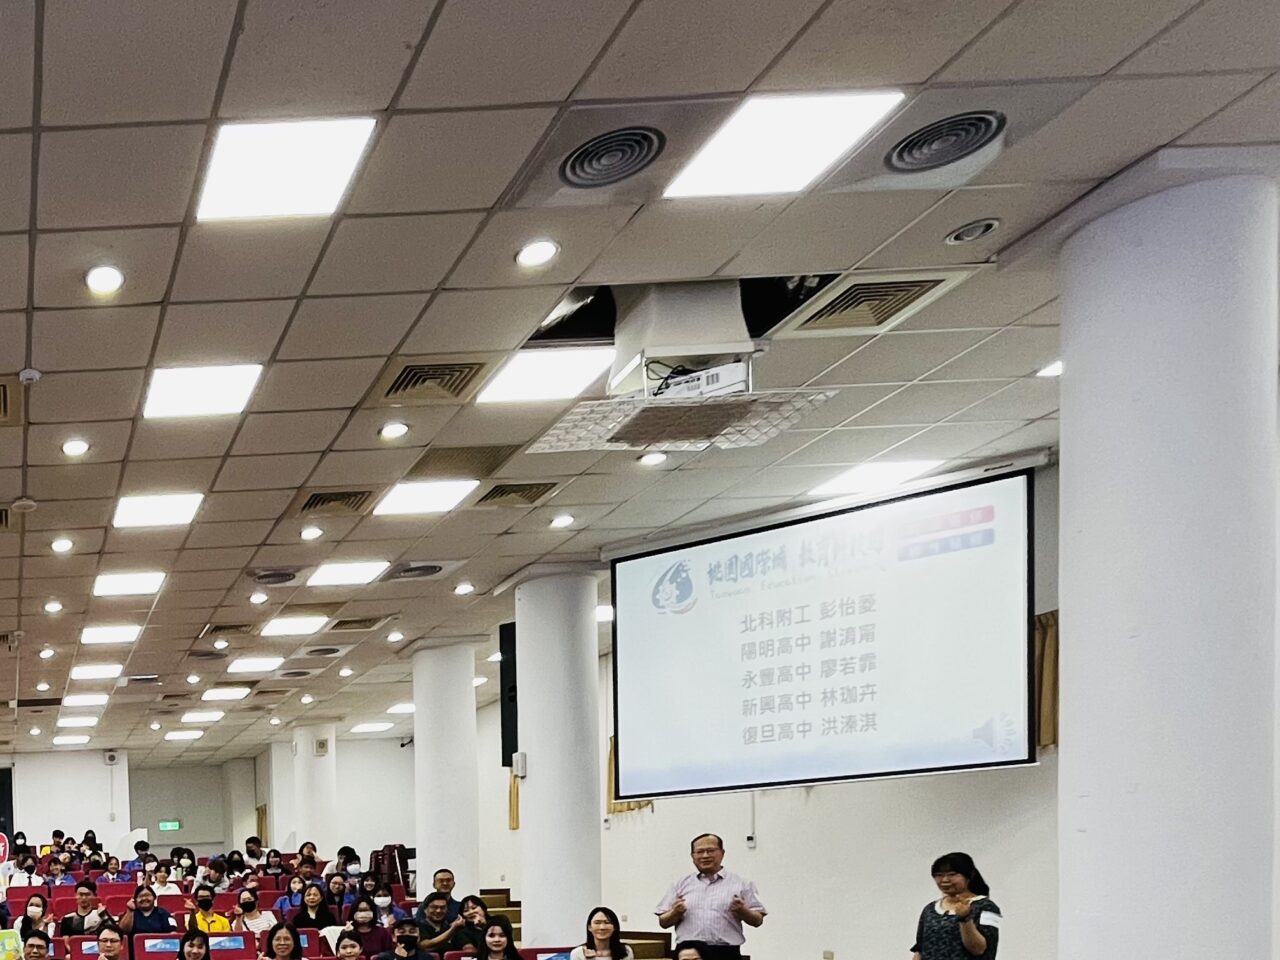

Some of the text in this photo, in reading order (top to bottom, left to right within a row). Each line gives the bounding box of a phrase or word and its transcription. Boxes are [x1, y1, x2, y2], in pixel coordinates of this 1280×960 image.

[741, 633, 811, 661] 陽明高中
[742, 662, 811, 689] 永豐高中
[742, 691, 812, 717] 新興高中
[743, 720, 812, 745] 復旦高中
